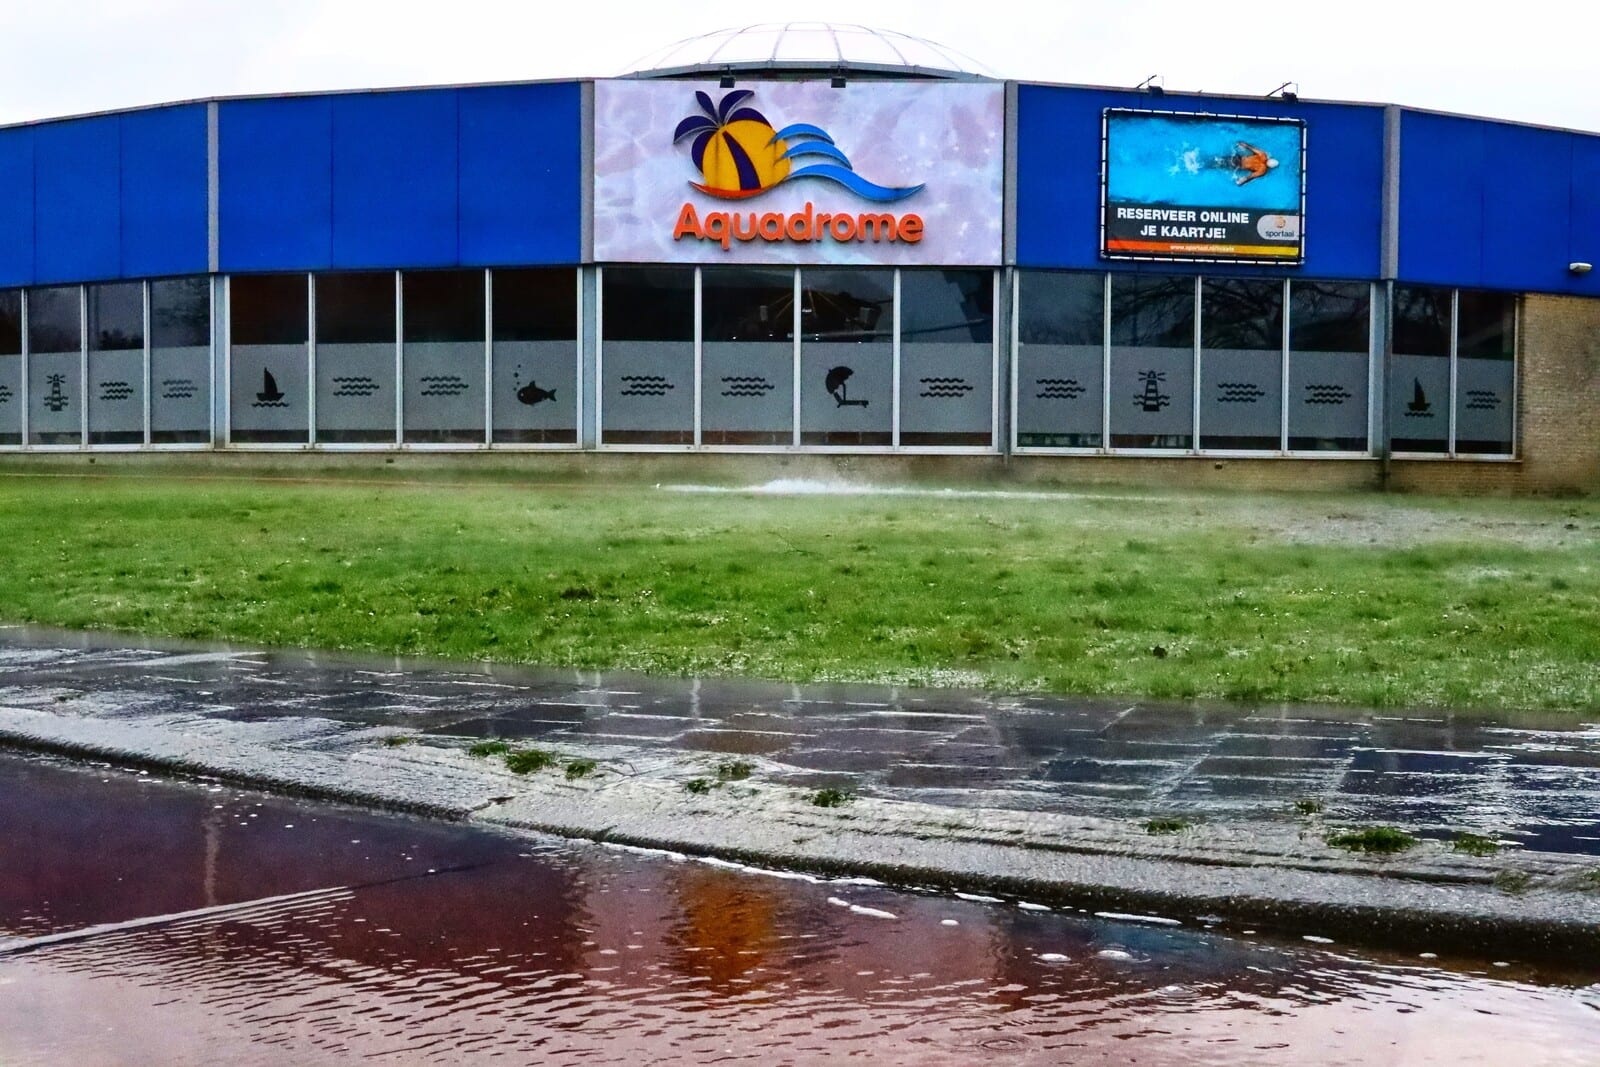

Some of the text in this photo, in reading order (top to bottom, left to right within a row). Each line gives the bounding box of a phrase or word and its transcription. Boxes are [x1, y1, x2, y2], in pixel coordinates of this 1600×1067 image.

[1117, 208, 1249, 224] RESERVEER ONLINE
[674, 202, 924, 250] Aquadrome
[1140, 225, 1226, 239] JE KAARTJE!
